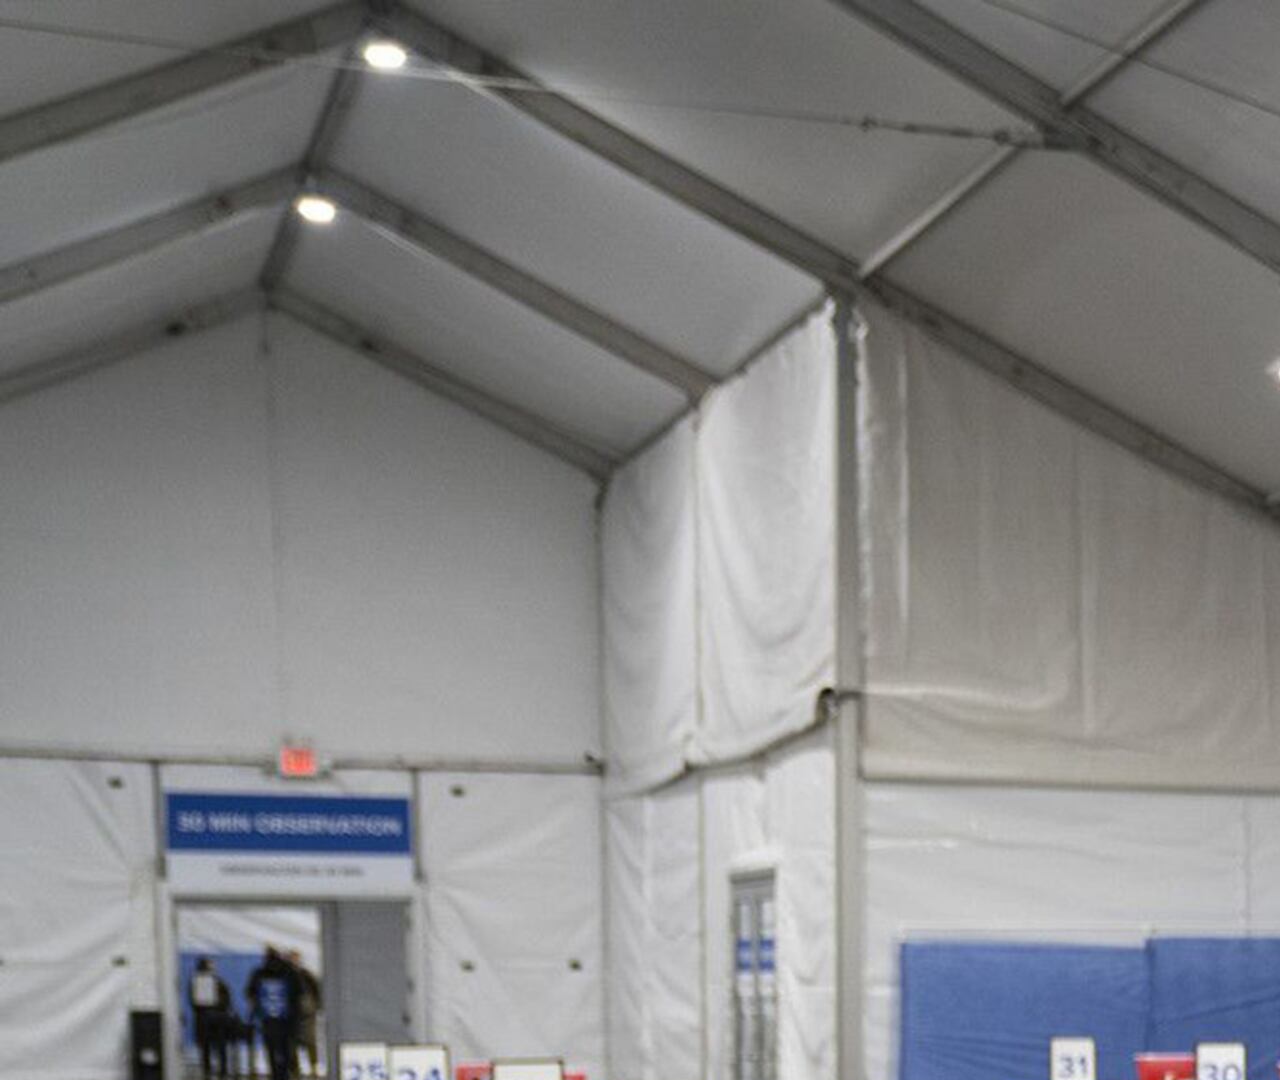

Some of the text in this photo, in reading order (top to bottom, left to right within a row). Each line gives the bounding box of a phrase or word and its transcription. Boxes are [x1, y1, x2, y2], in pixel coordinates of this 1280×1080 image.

[208, 810, 250, 834] MIN
[253, 811, 401, 837] OBSERVATION
[1060, 1057, 1087, 1078] 31
